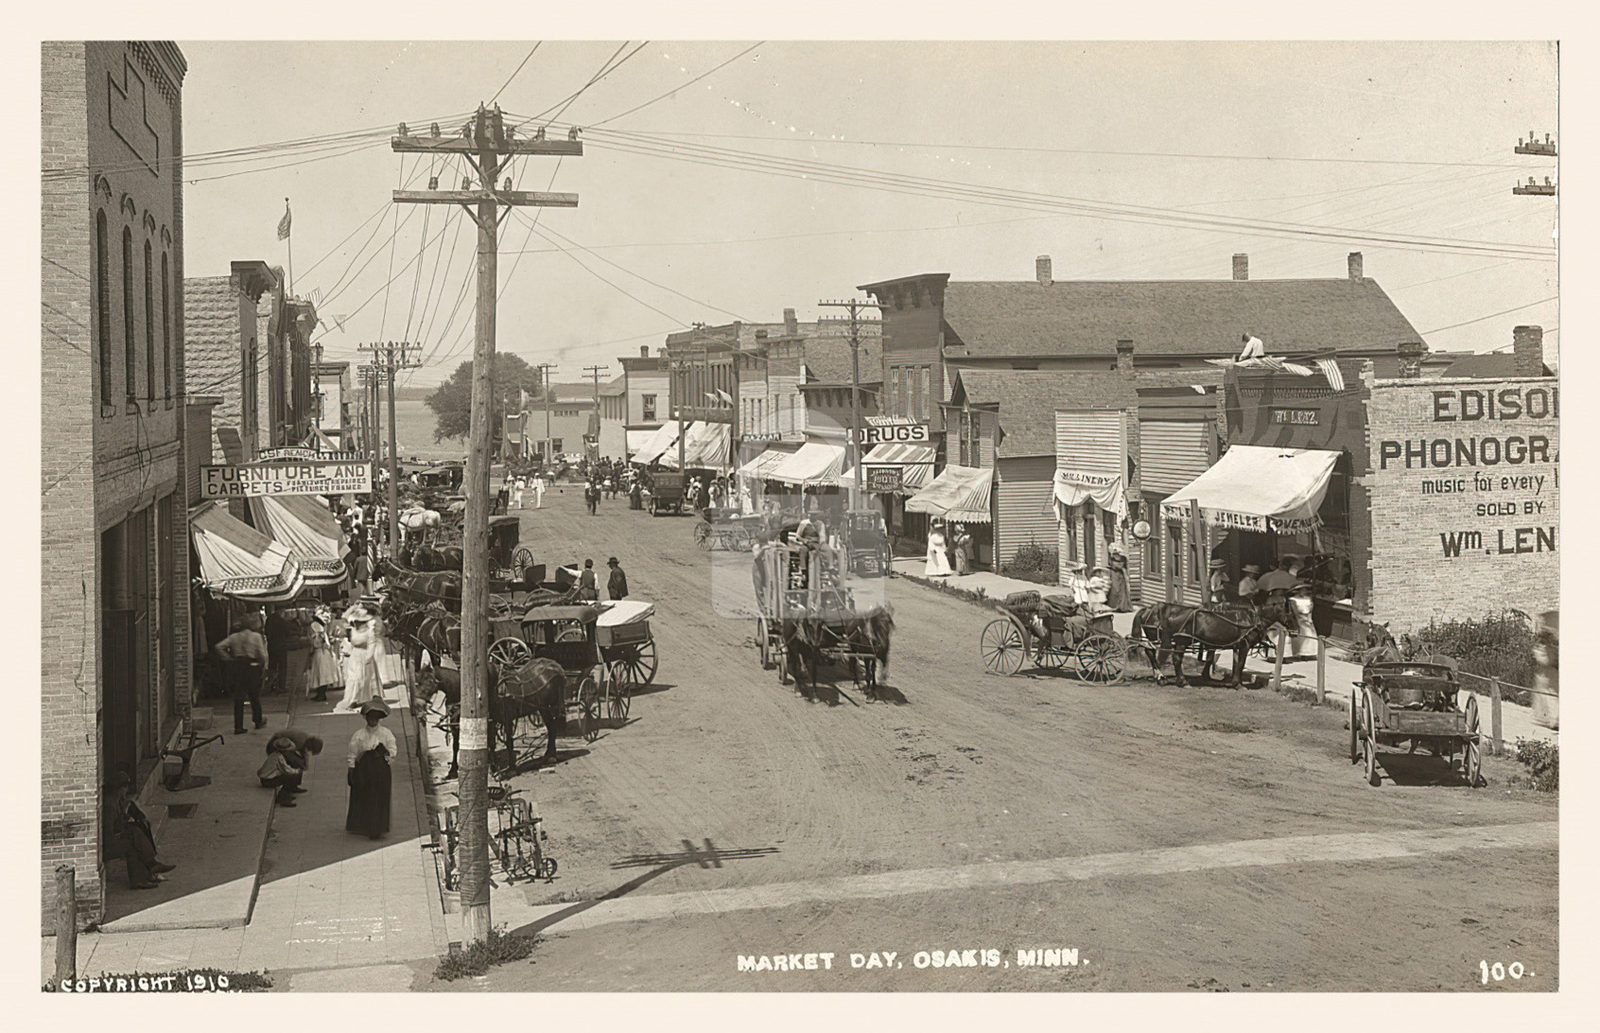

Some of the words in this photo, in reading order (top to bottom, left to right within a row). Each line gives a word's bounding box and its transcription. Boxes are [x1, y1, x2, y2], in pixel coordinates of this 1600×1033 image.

[1432, 388, 1559, 421] EDISO
[1380, 435, 1559, 470] PHONOGR
[207, 465, 326, 482] FURNITURE
[334, 465, 365, 478] AND
[1062, 472, 1111, 486] MILLINERY
[1421, 479, 1466, 494] music
[1474, 471, 1492, 492] for
[1500, 475, 1545, 495] every
[207, 481, 283, 495] CARPETS
[1476, 502, 1517, 517] SOLD
[1523, 500, 1545, 515] BY
[1497, 527, 1556, 555] LEN
